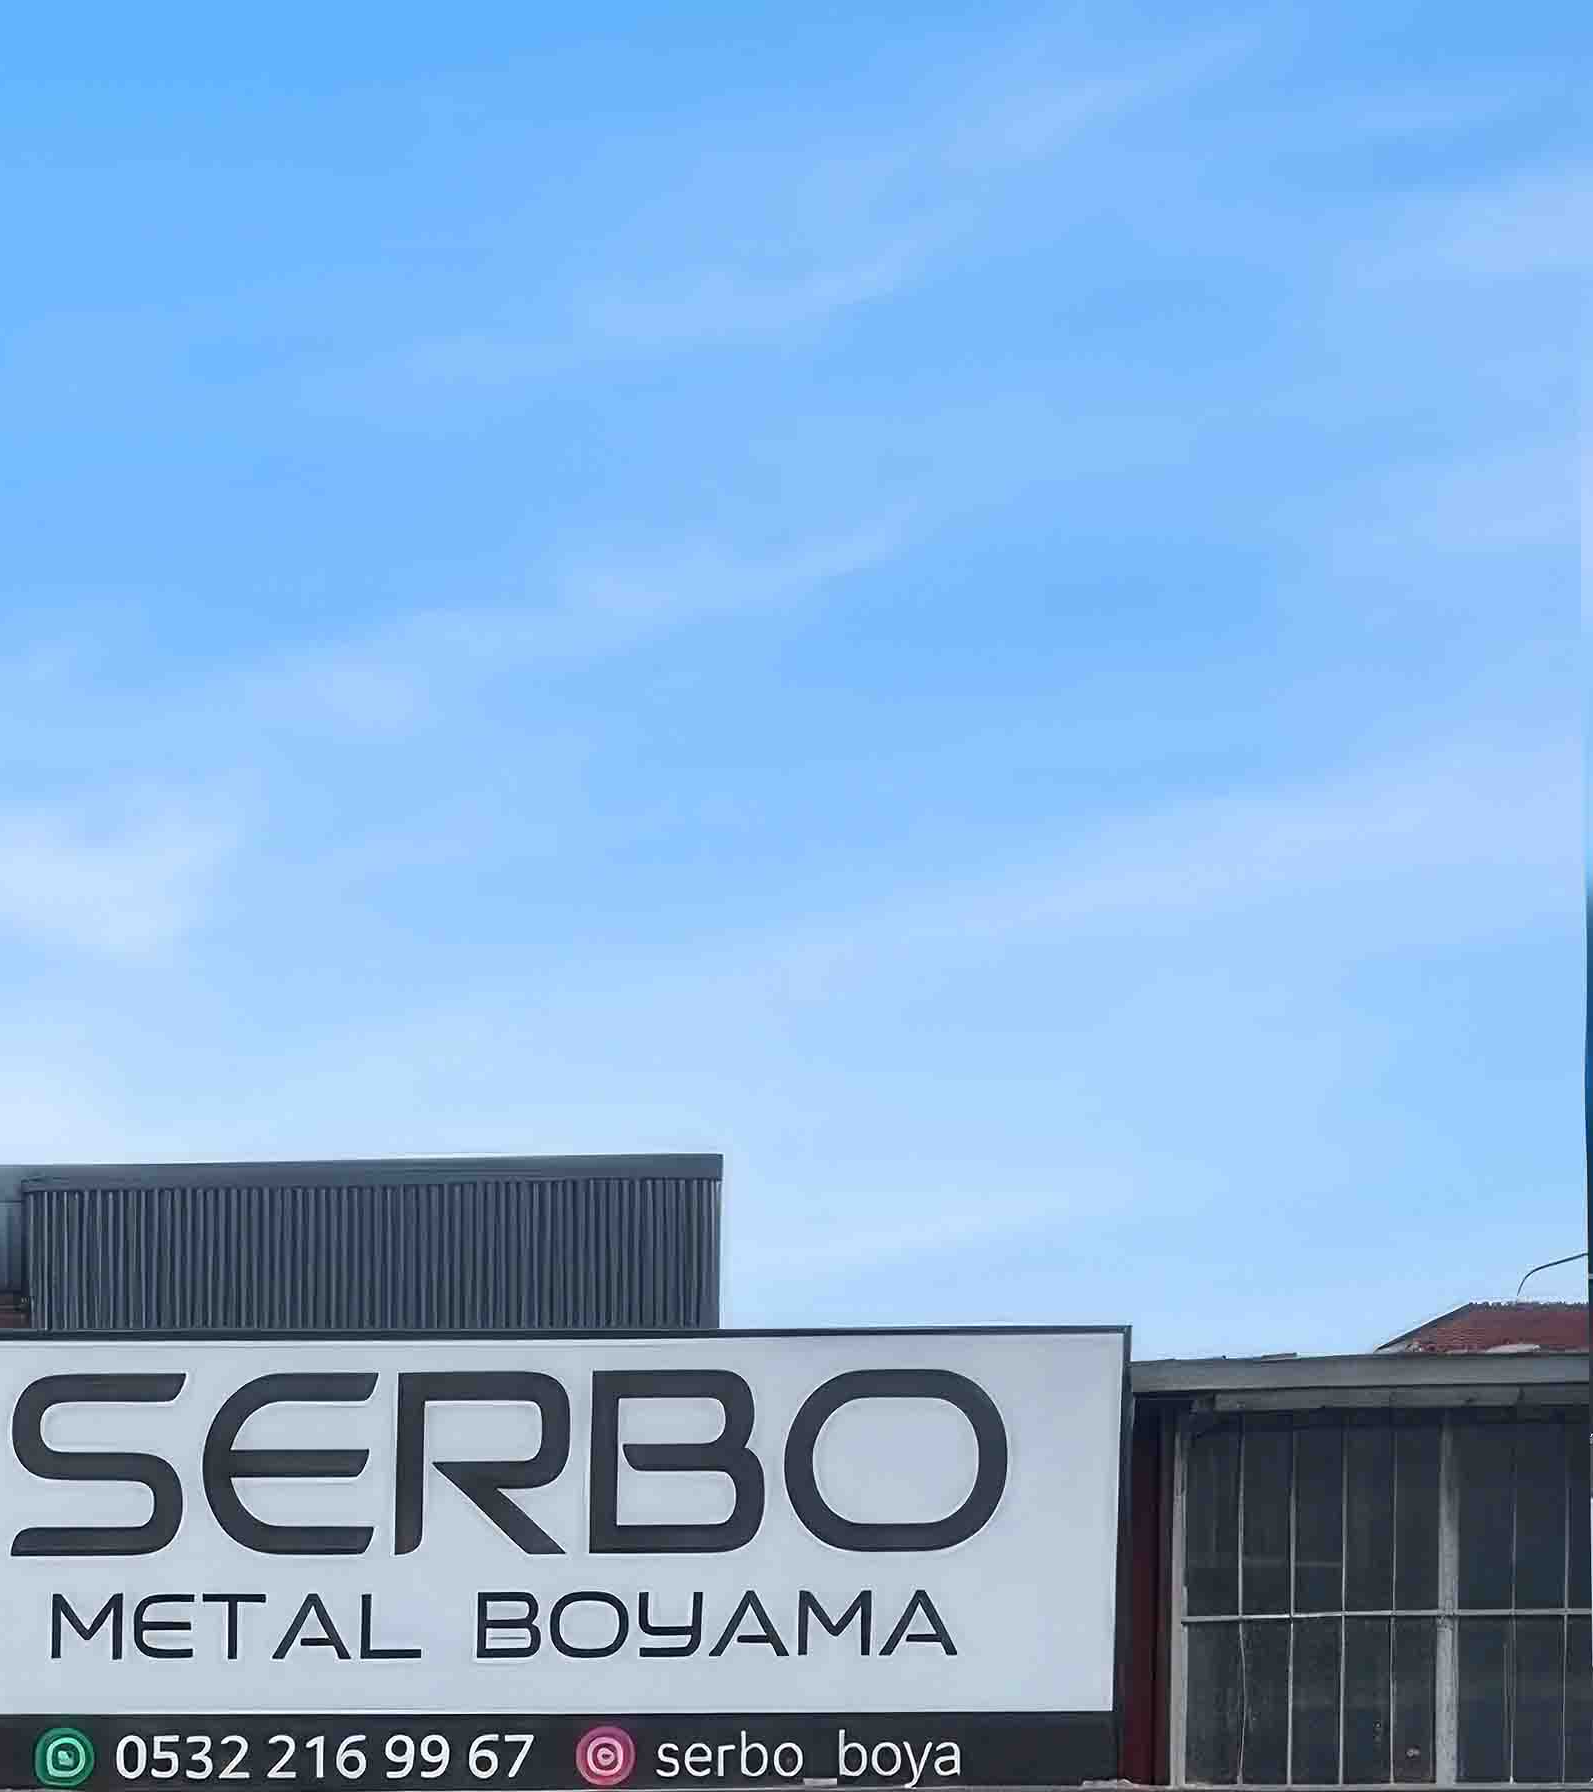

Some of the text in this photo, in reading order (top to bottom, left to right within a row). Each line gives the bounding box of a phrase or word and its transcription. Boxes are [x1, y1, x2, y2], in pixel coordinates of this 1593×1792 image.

[10, 1367, 1009, 1558] SERBO
[50, 1588, 959, 1661] METAL BOYAMA
[115, 1734, 536, 1780] 0532 216 99 67
[654, 1729, 962, 1789] serbo_boya
